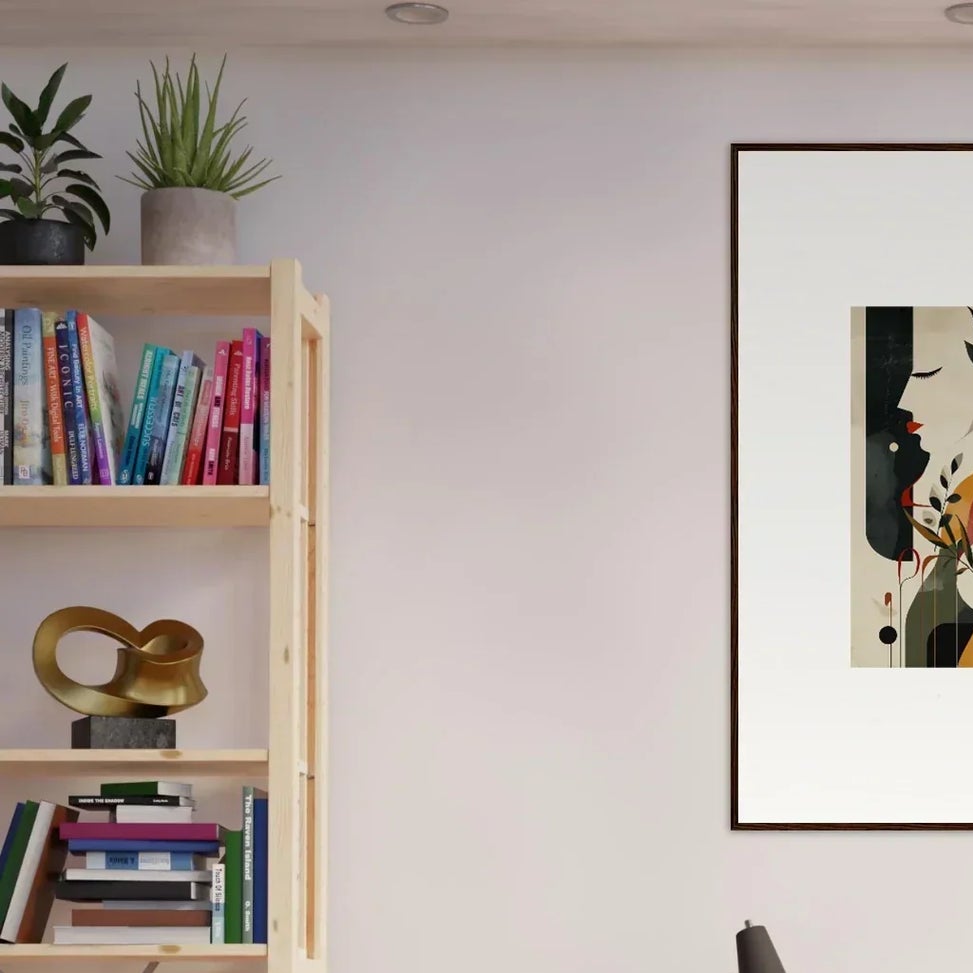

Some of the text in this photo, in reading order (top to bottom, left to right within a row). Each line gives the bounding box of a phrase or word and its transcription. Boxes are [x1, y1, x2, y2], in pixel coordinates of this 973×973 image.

[20, 324, 32, 385] Oil Paintings
[48, 365, 56, 380] ART
[78, 326, 93, 374] Watercolor
[58, 344, 73, 408] ICONIC
[230, 362, 240, 396] Parenting
[141, 395, 158, 446] SUCCESSFUL
[244, 794, 252, 813] The
